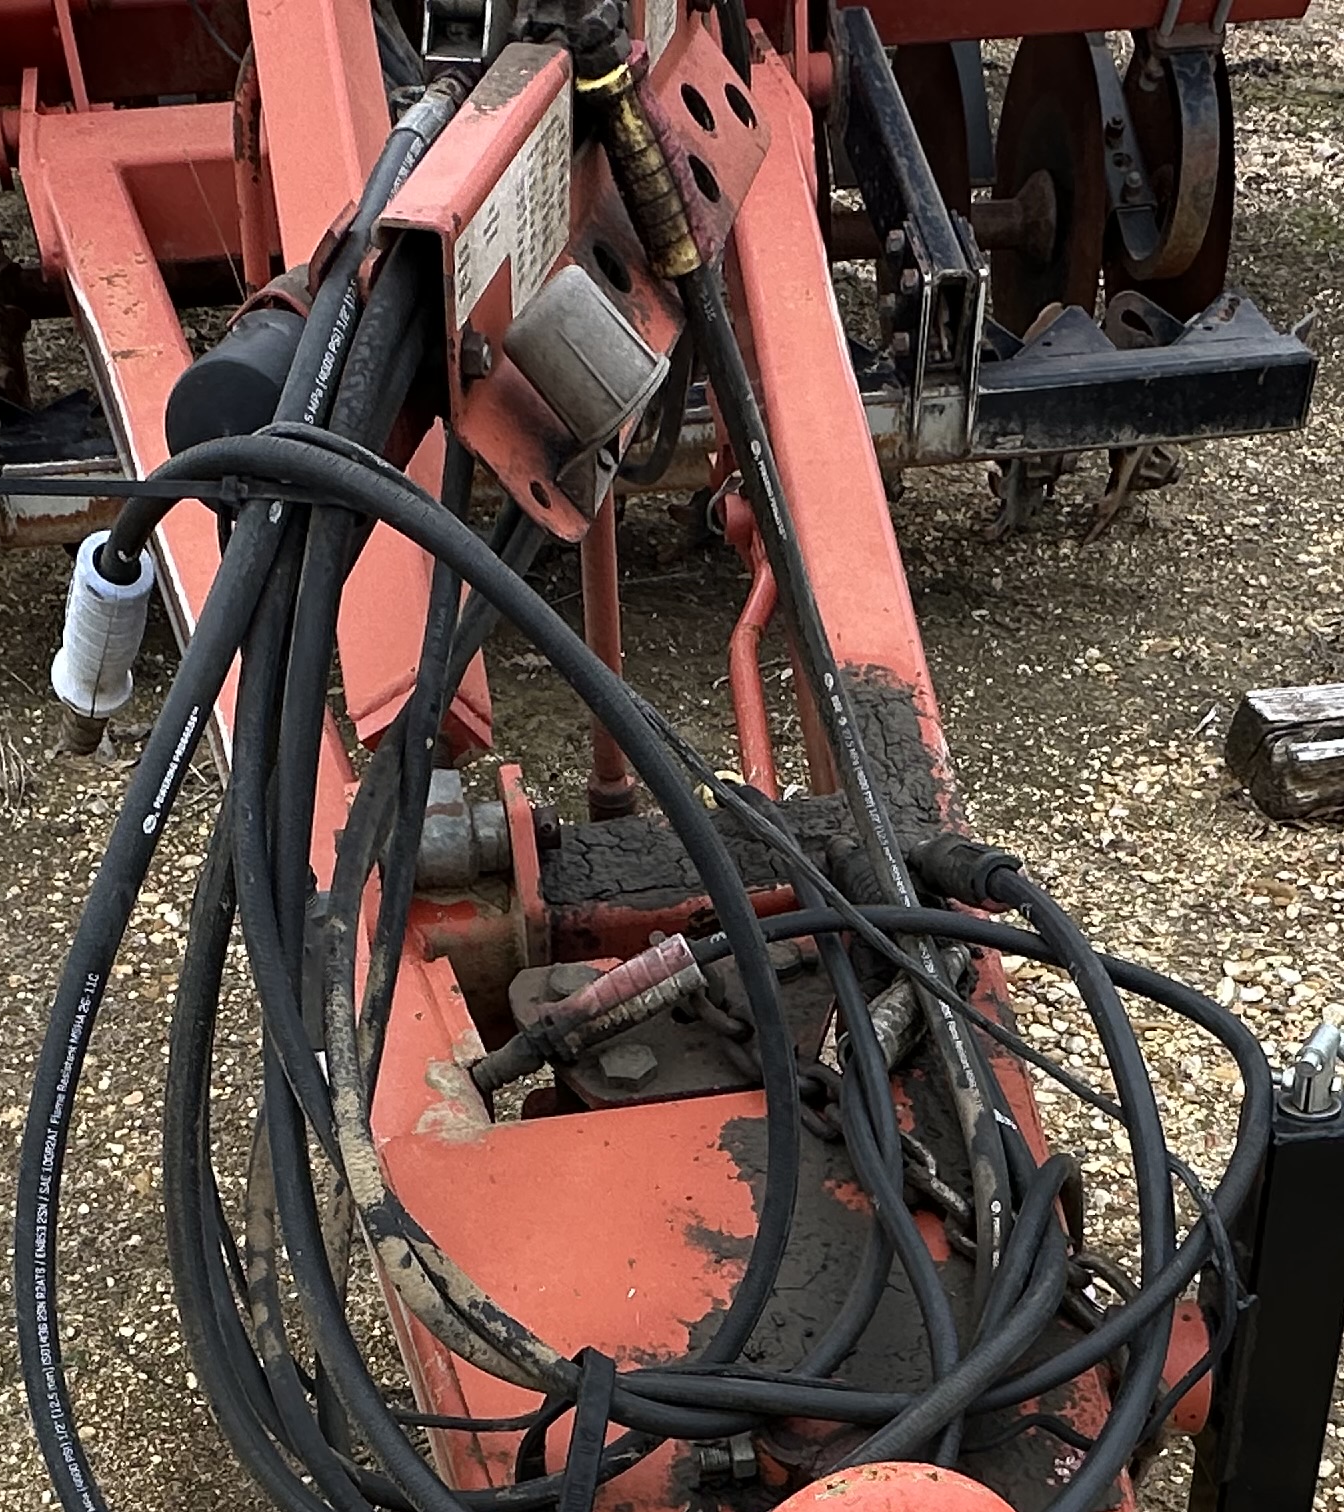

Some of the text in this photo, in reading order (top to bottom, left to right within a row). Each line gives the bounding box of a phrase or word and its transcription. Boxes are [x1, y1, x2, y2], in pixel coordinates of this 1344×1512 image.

[39, 1174, 52, 1194] SAE
[36, 1203, 48, 1224] 2SN
[36, 1301, 48, 1322] 2SN
